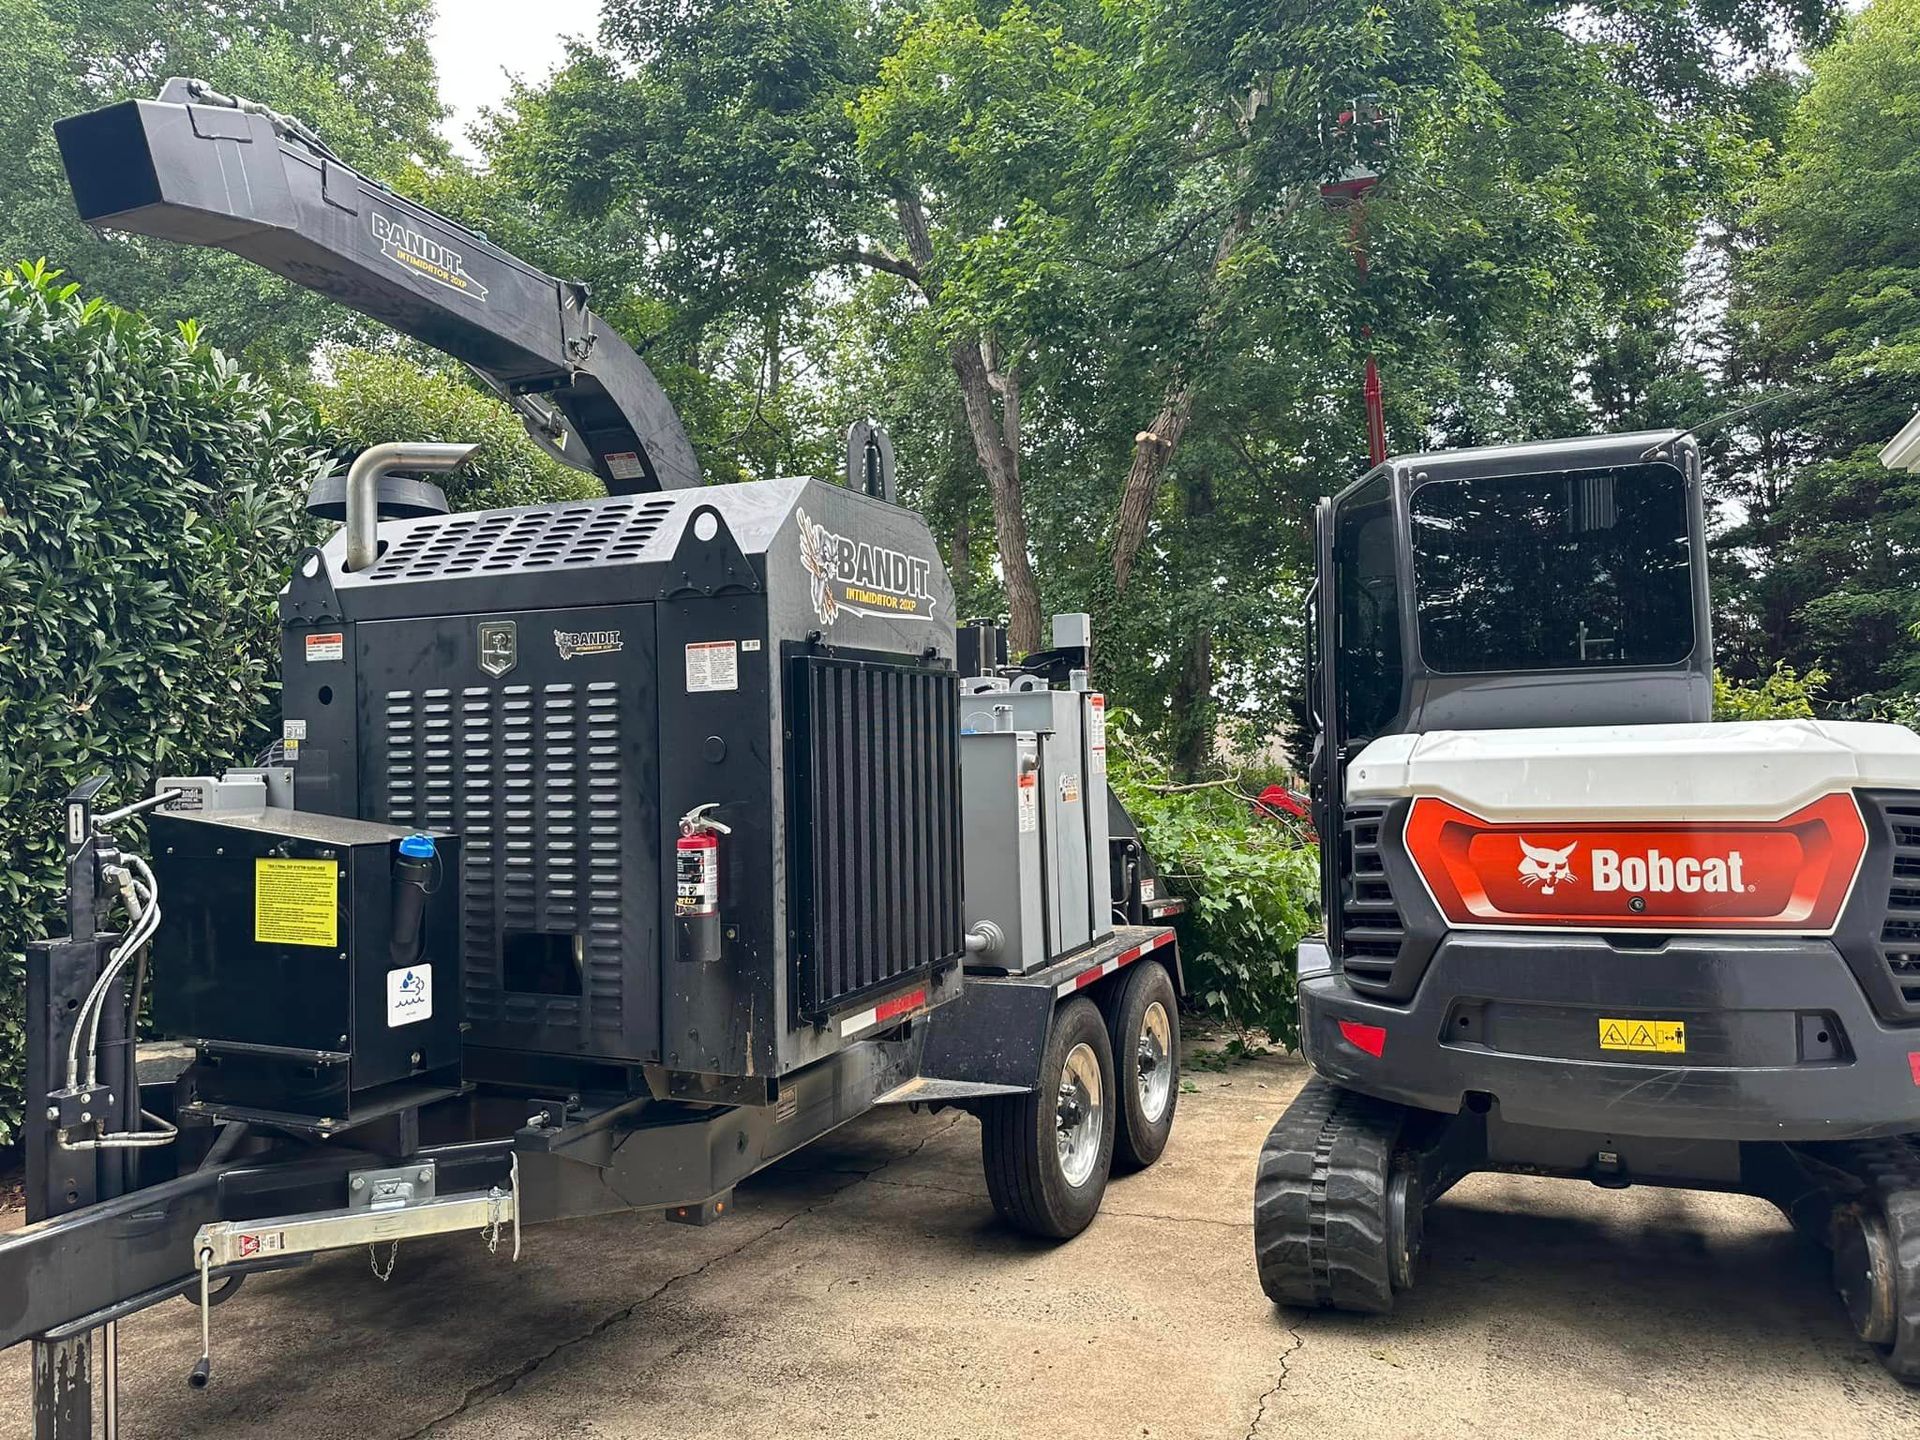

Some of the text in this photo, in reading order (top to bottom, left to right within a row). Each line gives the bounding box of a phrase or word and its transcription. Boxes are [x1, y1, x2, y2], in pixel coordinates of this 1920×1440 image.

[371, 211, 462, 276] BANDIT
[396, 249, 449, 282] INTIMIDATOR
[836, 536, 929, 599] BANDIT
[846, 587, 898, 609] INTIMIDATOR
[570, 630, 620, 647] BANDIT
[1591, 848, 1745, 893] Bobcat
